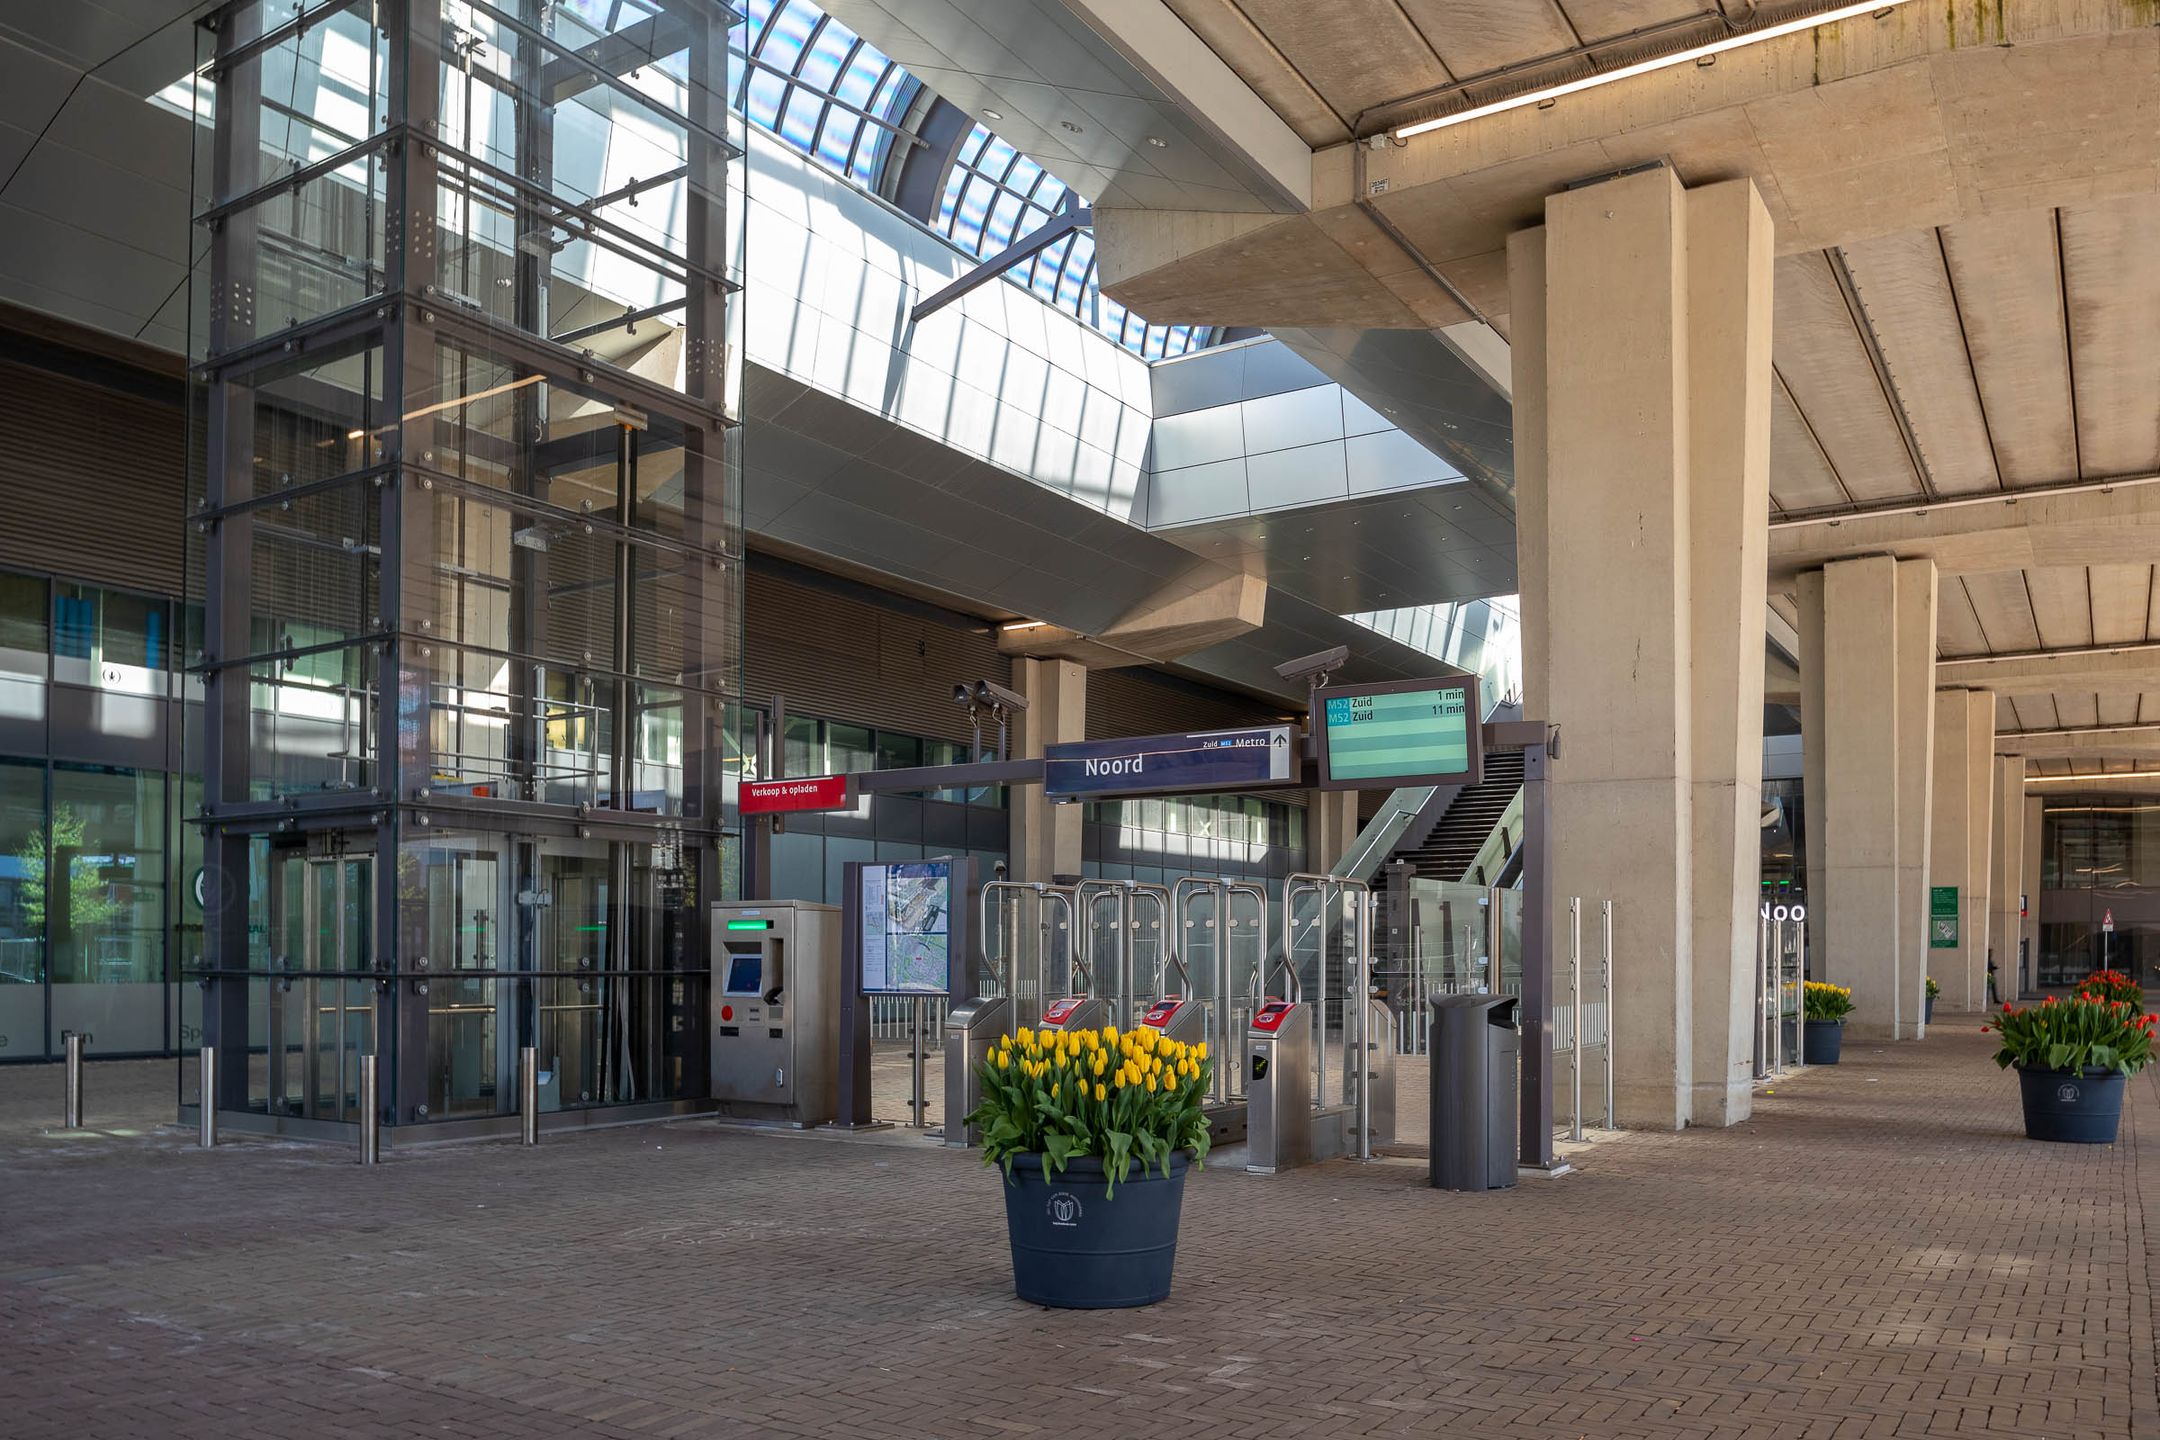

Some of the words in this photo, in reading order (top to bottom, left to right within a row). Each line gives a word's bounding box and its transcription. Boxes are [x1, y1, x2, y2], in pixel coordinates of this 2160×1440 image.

[1328, 700, 1348, 710] M52
[1352, 696, 1373, 708] Zuid
[1437, 690, 1442, 700] 1
[1446, 689, 1464, 700] min
[1328, 712, 1349, 723] M52
[1352, 710, 1373, 722] Zuid
[1432, 704, 1443, 715] 11
[1446, 703, 1465, 714] min
[1203, 740, 1218, 748] Zuid
[1235, 738, 1266, 748] Metro
[1085, 753, 1143, 776] Noord
[751, 787, 780, 797] Verkoop
[781, 786, 788, 795] &
[789, 784, 818, 796] opladen
